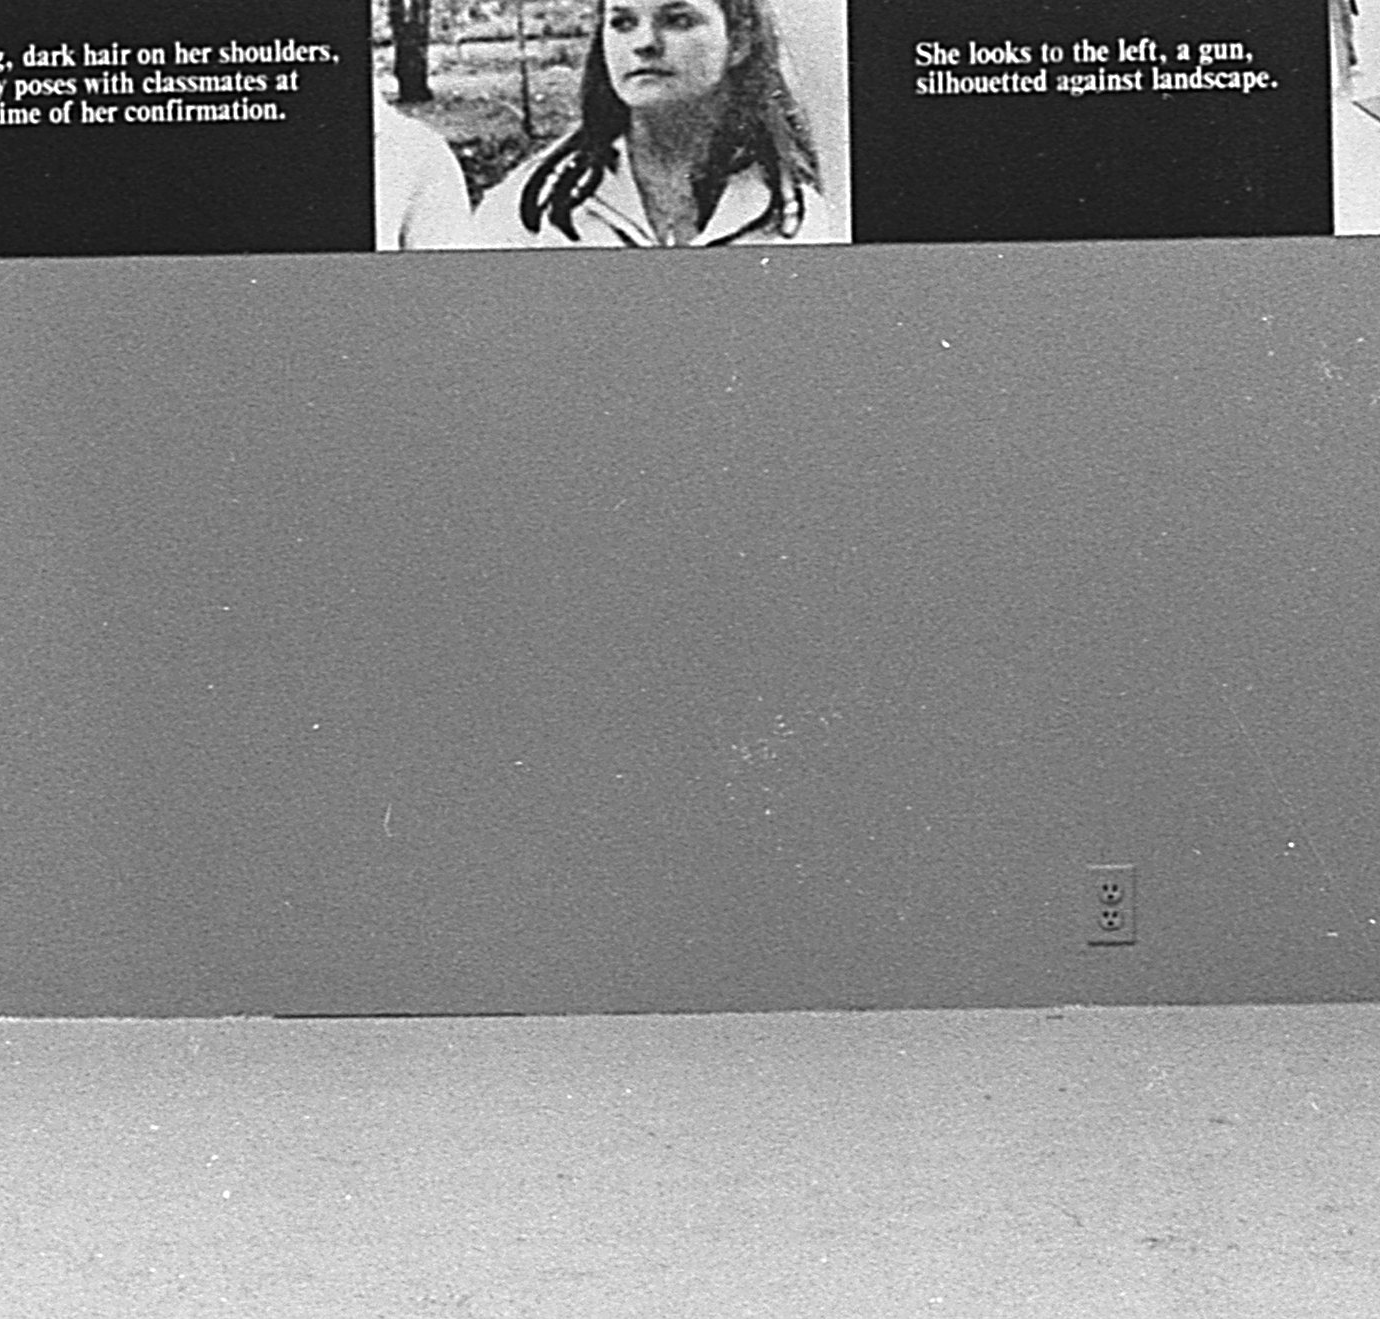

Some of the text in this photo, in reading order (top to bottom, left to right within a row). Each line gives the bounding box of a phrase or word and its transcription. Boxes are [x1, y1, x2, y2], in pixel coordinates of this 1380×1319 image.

[23, 43, 76, 66] dark
[84, 42, 131, 66] hair
[137, 48, 165, 64] on
[175, 41, 212, 64] her
[219, 39, 339, 63] shoulders,
[916, 38, 1252, 67] She looks to the left, a gun,
[15, 78, 77, 102] poses
[84, 71, 134, 94] with
[143, 70, 267, 93] classmates
[276, 70, 298, 91] at
[916, 66, 1278, 95] silhouetted against landscape.
[49, 100, 73, 123] of
[81, 100, 118, 123] her
[125, 97, 285, 122] confirmation.
